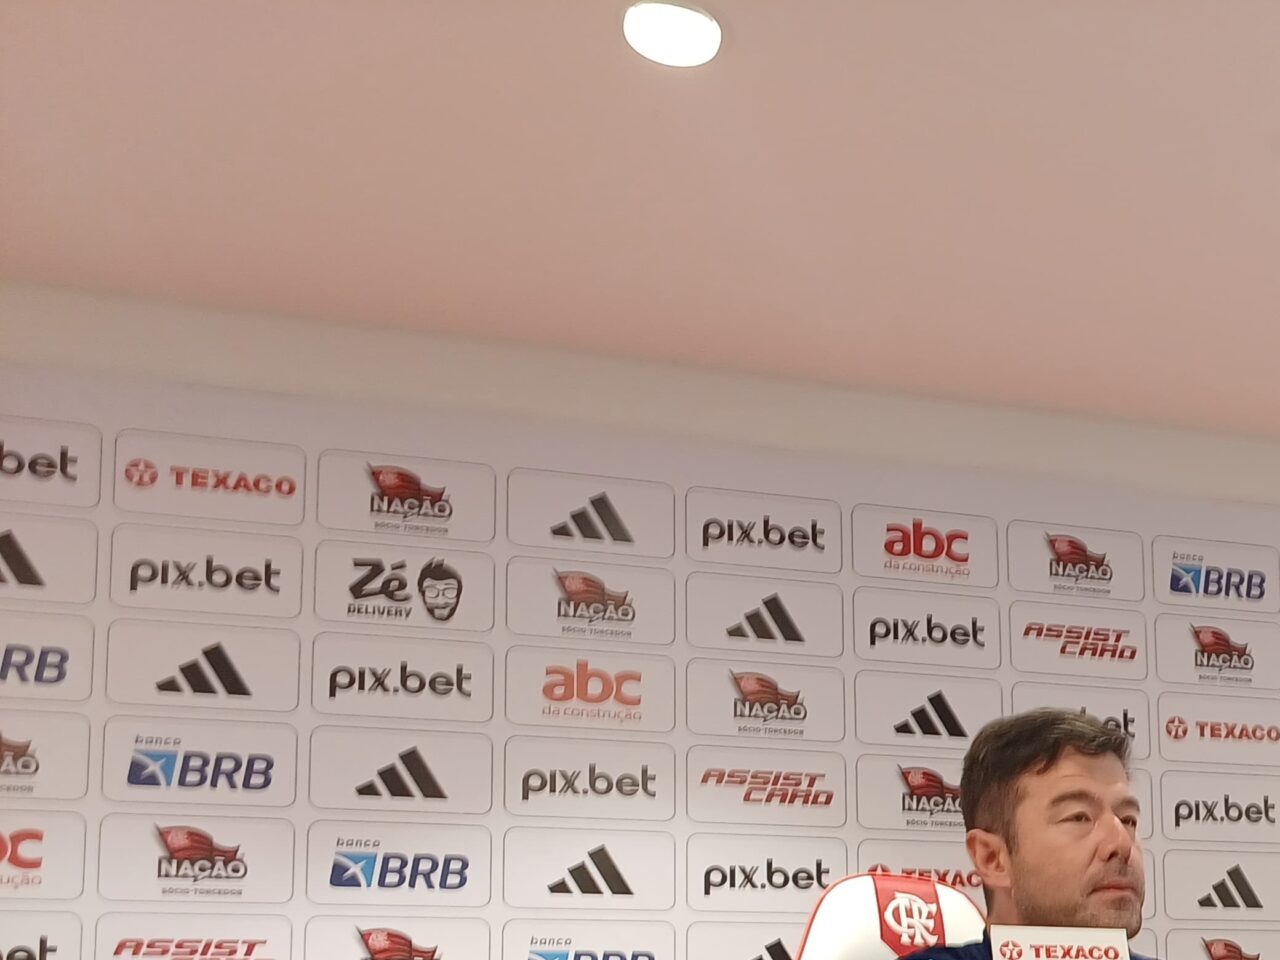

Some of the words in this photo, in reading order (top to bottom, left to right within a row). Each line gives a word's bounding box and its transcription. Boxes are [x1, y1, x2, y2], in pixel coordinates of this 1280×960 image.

[169, 465, 296, 496] TEXACO
[703, 515, 826, 552] pix.bet
[884, 517, 969, 563] abc
[1172, 551, 1204, 562] banco
[129, 557, 281, 594] pix.bet
[348, 557, 412, 602] Zé
[1203, 566, 1266, 600] BRB
[347, 602, 413, 621] DELIVERY
[869, 614, 985, 648] pix.bet
[1023, 622, 1130, 643] ASSIST
[1059, 640, 1137, 662] CARD
[328, 661, 472, 697] pix.bet
[541, 660, 642, 706] abc
[542, 704, 560, 717] da
[563, 706, 642, 724] construção
[134, 735, 181, 747] banco
[1196, 720, 1280, 742] TEXACO
[179, 752, 275, 791] BRB
[521, 765, 656, 800] pix.bet
[701, 767, 826, 789] ASSIST
[742, 787, 834, 808] CARD
[1175, 794, 1275, 827] pix.bet
[335, 837, 380, 848] banco
[157, 855, 248, 884] NAÇÃO
[377, 853, 470, 892] BRB
[704, 859, 829, 895] pix.bet
[901, 867, 983, 887] TEXAC
[113, 936, 268, 960] ASSIST
[530, 935, 572, 947] banco
[1030, 944, 1120, 960] TEXACO
